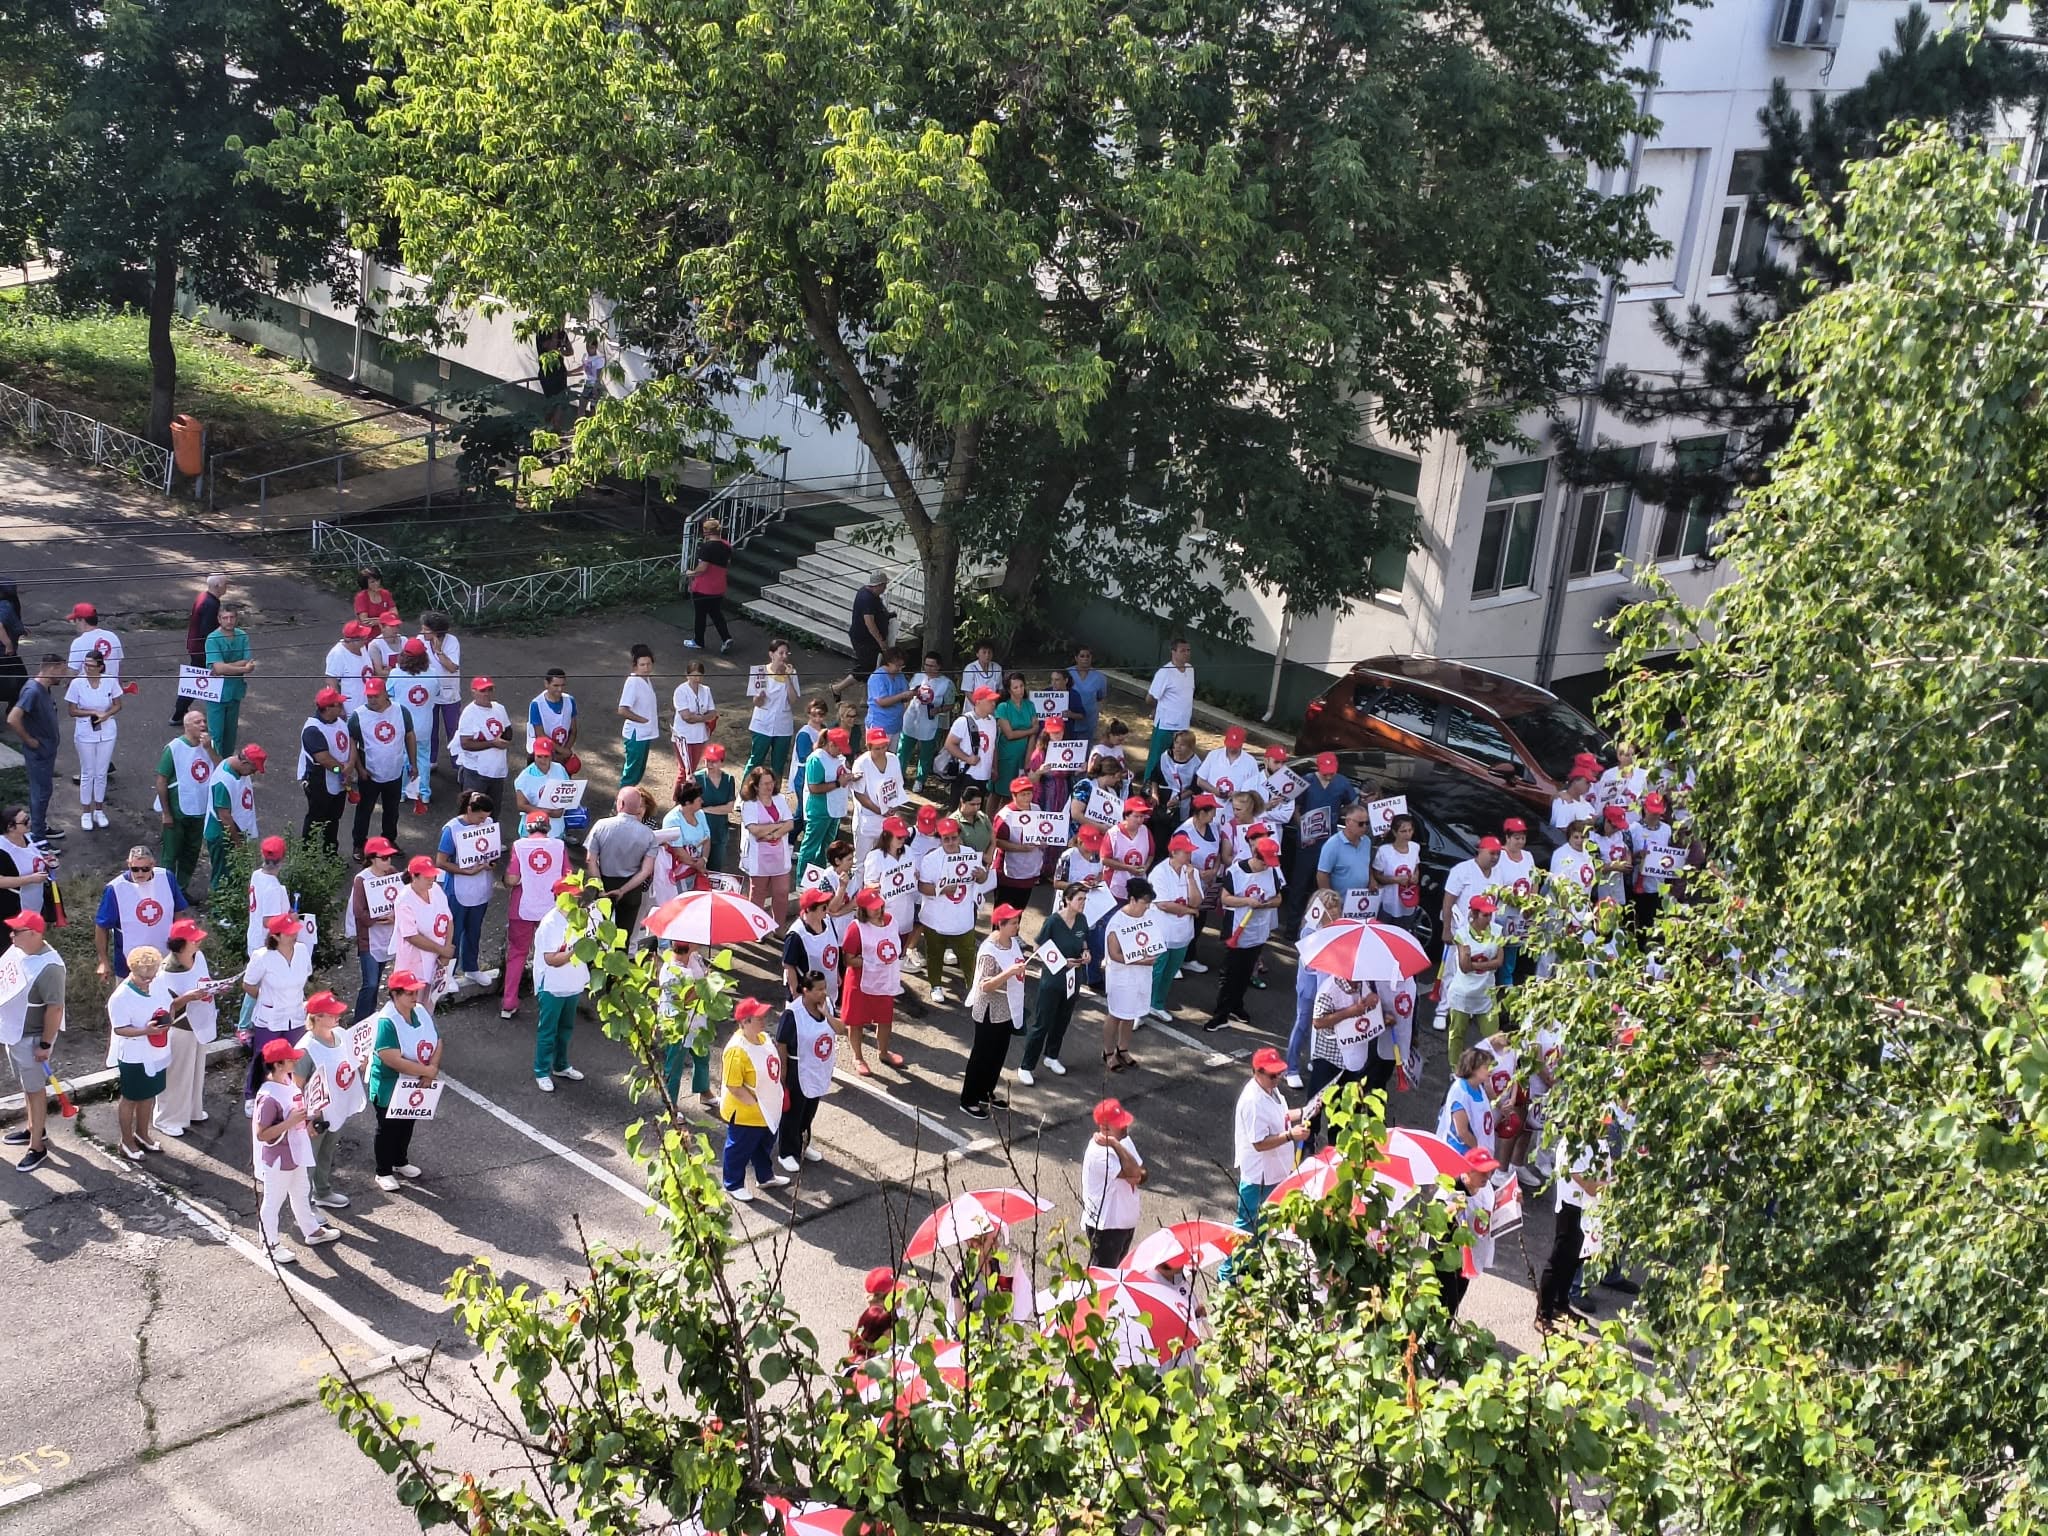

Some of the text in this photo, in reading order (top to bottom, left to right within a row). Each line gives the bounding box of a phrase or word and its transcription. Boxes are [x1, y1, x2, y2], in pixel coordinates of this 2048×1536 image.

[181, 686, 219, 699] VRANCEA
[882, 782, 896, 795] STOP
[1372, 798, 1401, 809] SANITAS
[1088, 810, 1117, 825] VRANCE
[463, 826, 496, 840] SANITAS
[462, 850, 499, 865] VRANCEA
[1652, 845, 1685, 856] SANITAS
[947, 854, 978, 862] SANITAS
[885, 862, 913, 878] SANITAS
[370, 875, 401, 888] SANITA
[883, 882, 915, 900] VRANCEA
[372, 903, 394, 915] VRAN
[1121, 920, 1153, 935] SANITAS
[1126, 943, 1163, 960] VRANCEA
[354, 1026, 372, 1045] STOP
[1340, 1024, 1383, 1045] VRANCEA
[390, 1108, 432, 1117] VRANCEA
